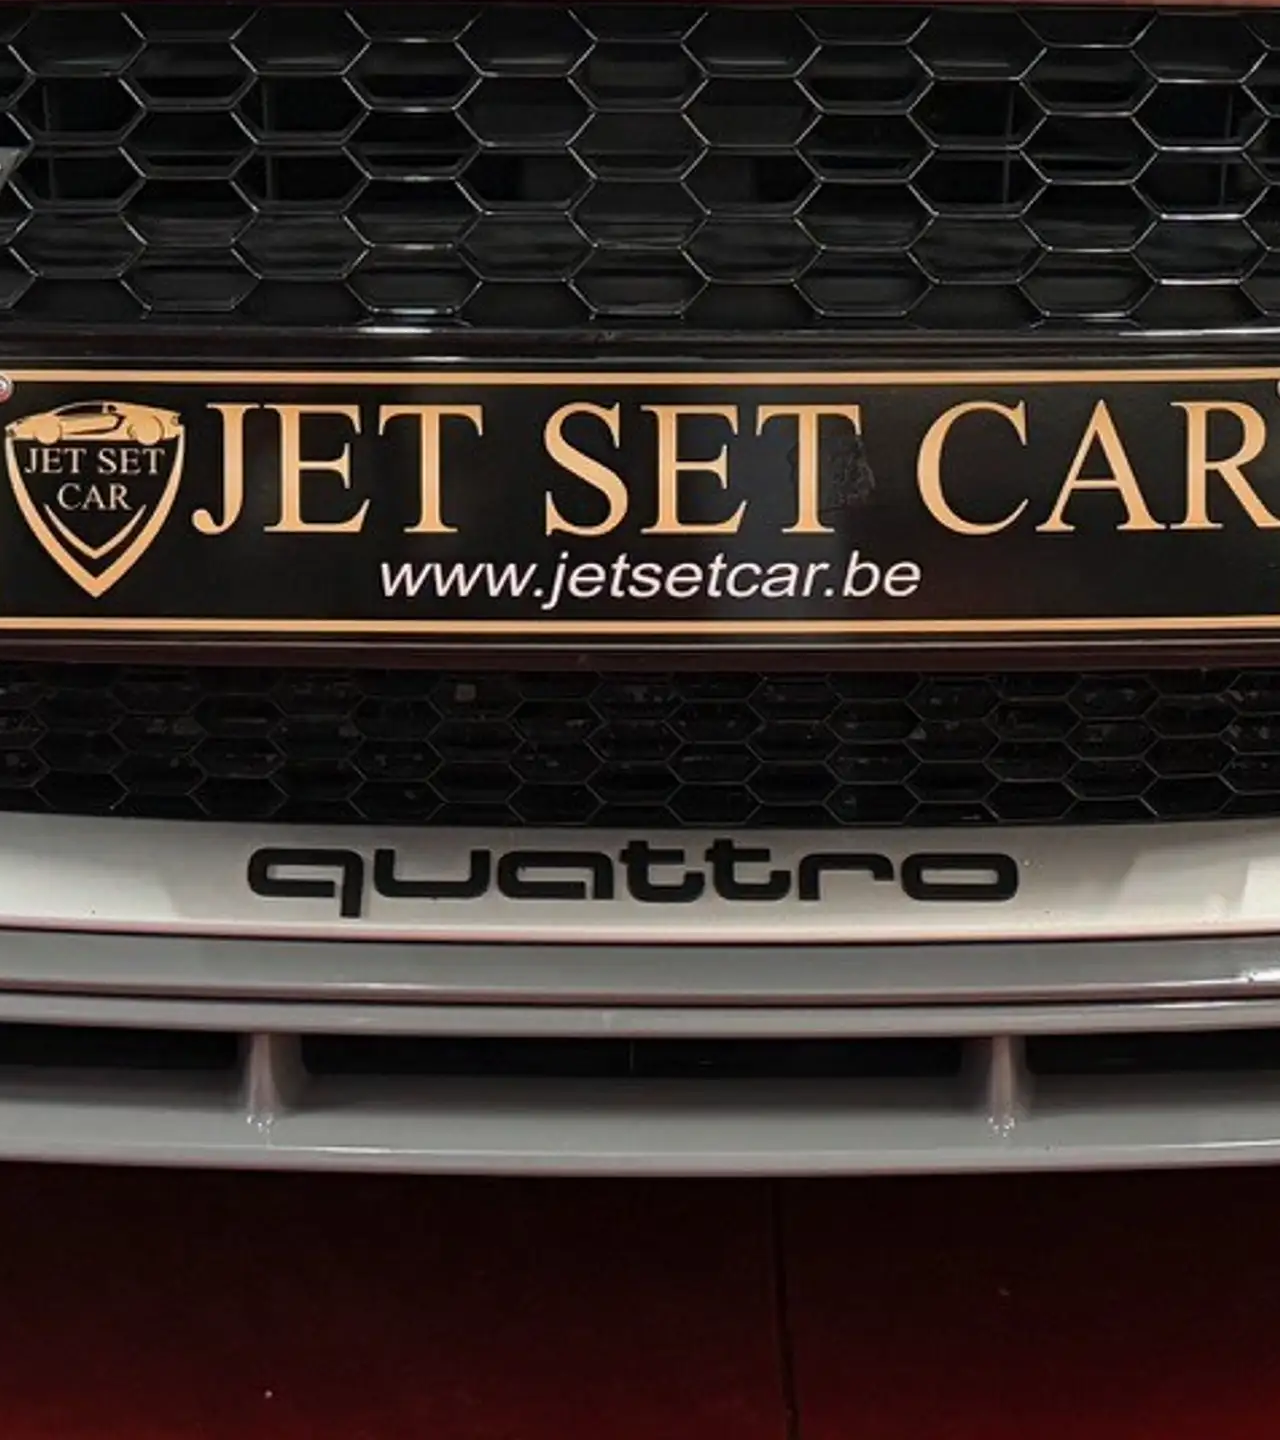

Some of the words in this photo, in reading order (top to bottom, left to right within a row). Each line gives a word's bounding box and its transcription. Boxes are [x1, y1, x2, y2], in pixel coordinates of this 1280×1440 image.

[24, 447, 87, 474] JET
[97, 447, 166, 475] SET
[191, 403, 483, 536] JET
[543, 401, 862, 537] SET
[56, 482, 133, 510] CAR
[380, 550, 921, 610] www.jetsetcar.be
[247, 837, 1019, 919] quattro
